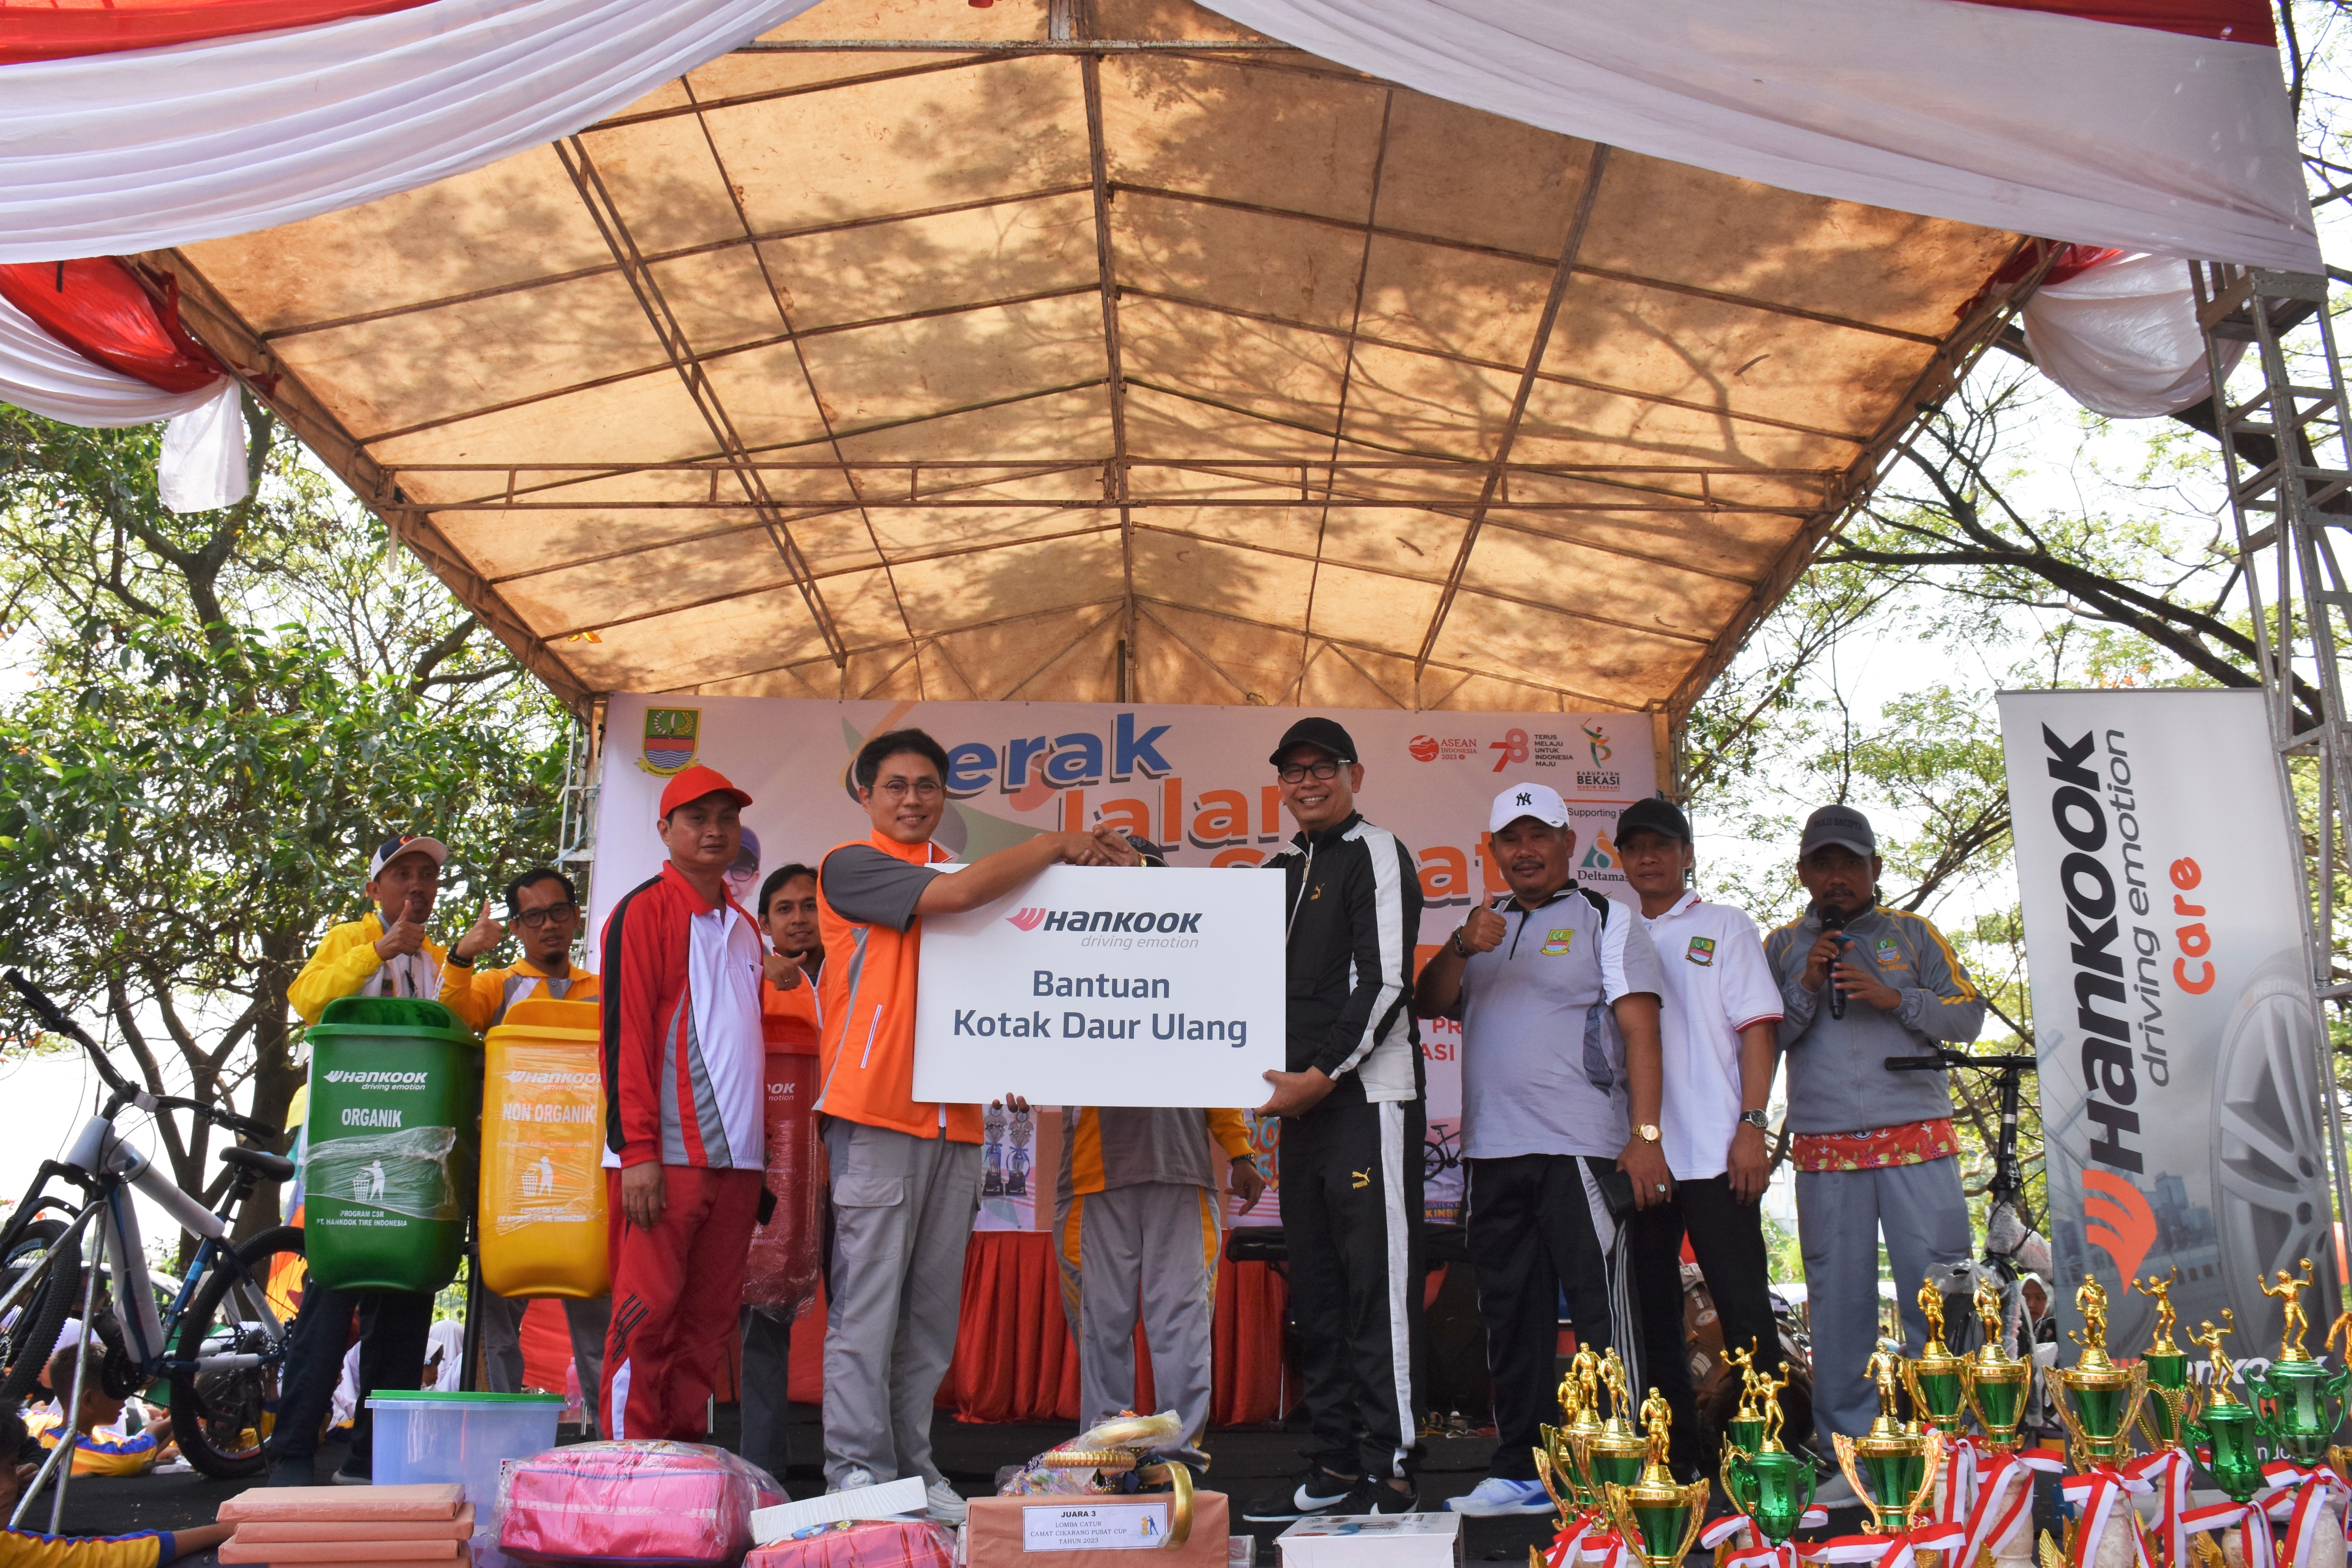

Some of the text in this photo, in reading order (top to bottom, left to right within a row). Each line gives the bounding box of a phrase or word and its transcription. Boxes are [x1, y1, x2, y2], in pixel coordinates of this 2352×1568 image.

[1441, 739, 1477, 747] ASEAN
[946, 713, 1173, 795] erak
[1577, 776, 1620, 785] BEKASI
[1568, 808, 1616, 819] Supporting
[2106, 729, 2169, 1087] driving emotion
[1081, 935, 1199, 951] driving emotion
[1032, 970, 1170, 999] Bantuan
[954, 1009, 1248, 1049] Kotak Daur Ulang
[361, 1083, 390, 1091] driving
[342, 1108, 402, 1128] ORGANIK
[503, 1103, 596, 1124] NON ORGANIK
